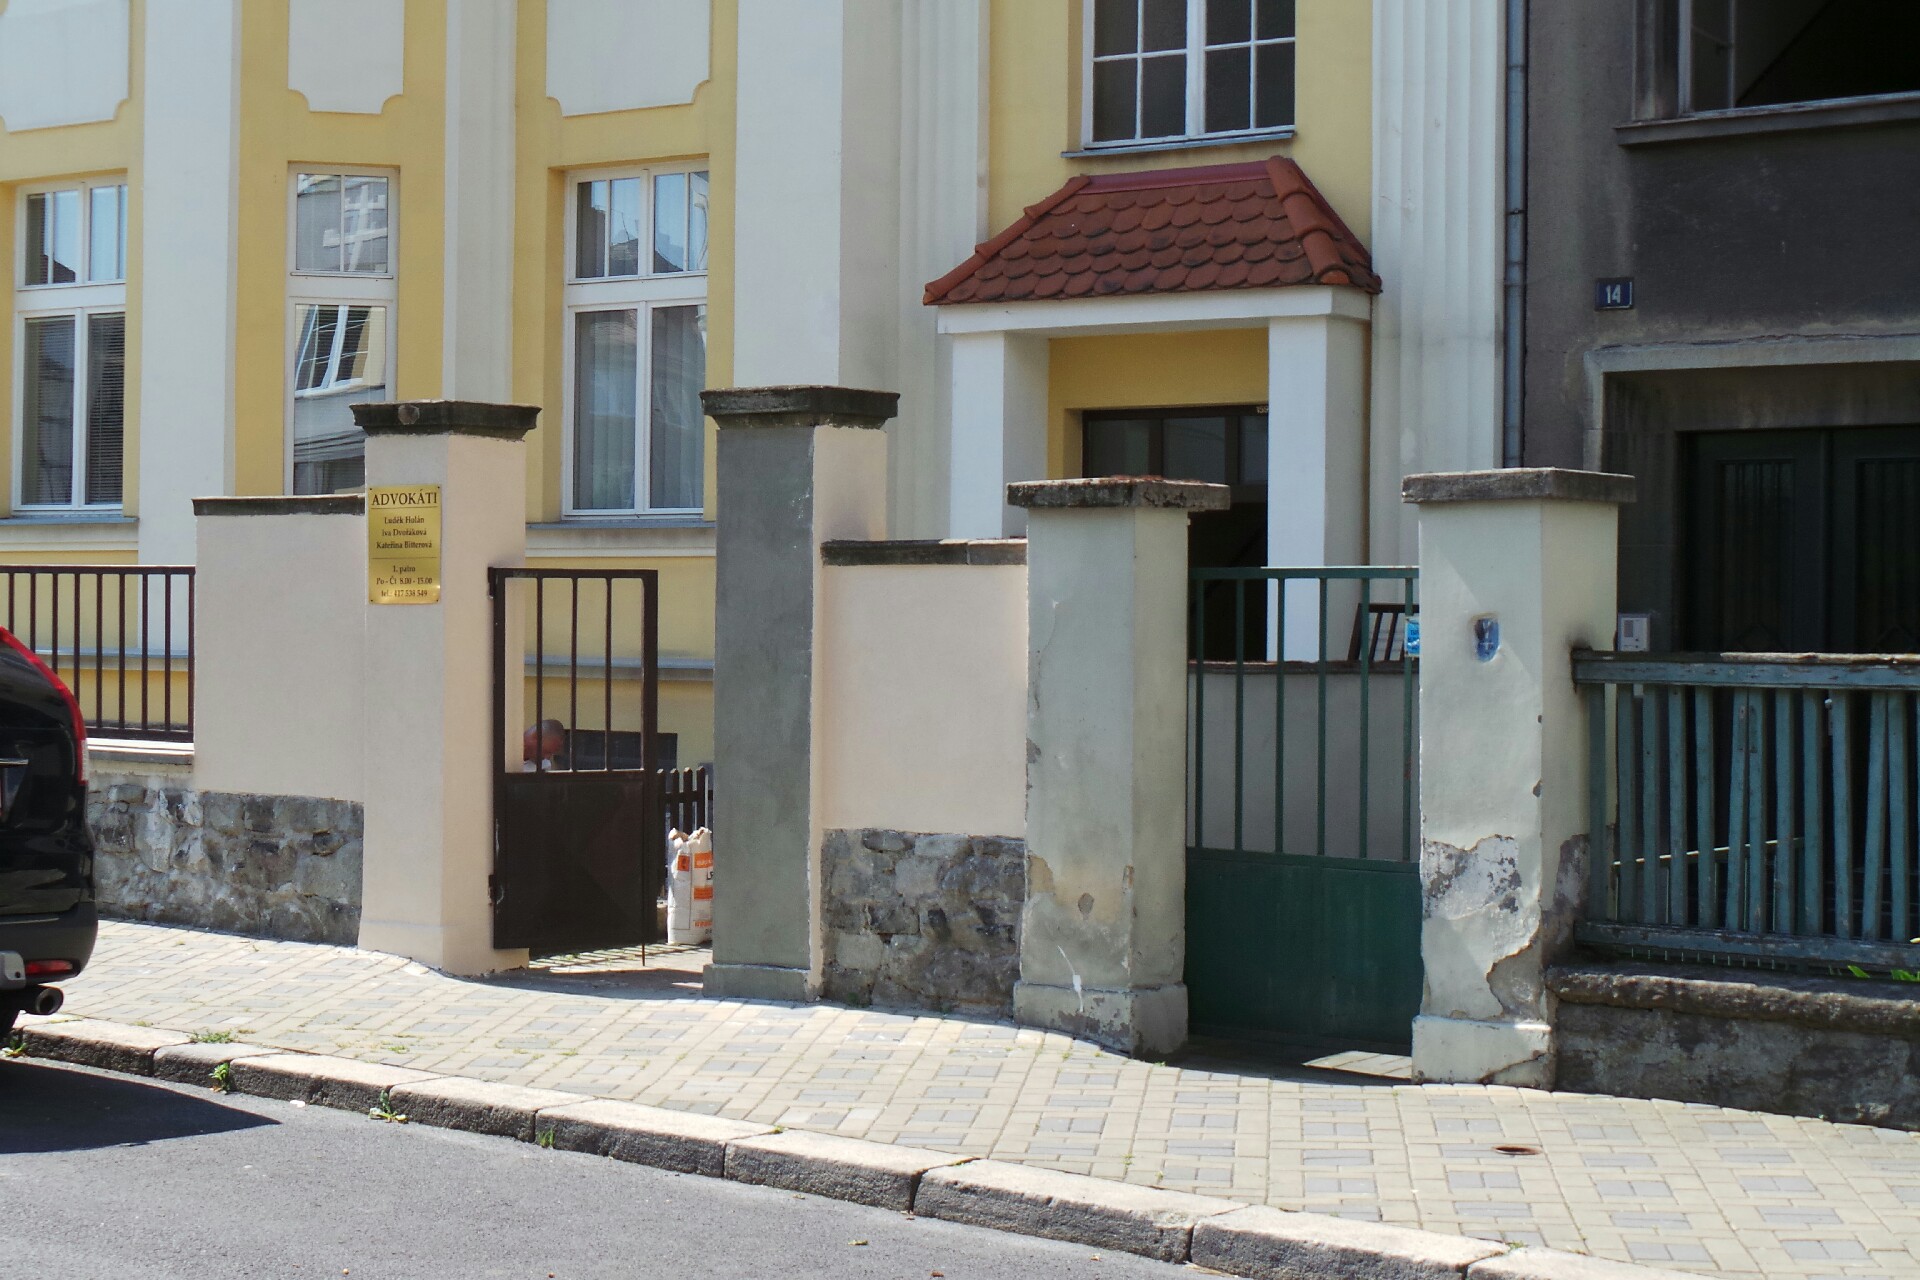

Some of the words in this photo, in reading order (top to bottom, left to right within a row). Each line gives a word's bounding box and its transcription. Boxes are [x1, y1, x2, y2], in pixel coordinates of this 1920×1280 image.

[1605, 284, 1621, 304] 14
[372, 489, 437, 506] ADVOKÁTI
[384, 516, 404, 524] Luděk
[405, 515, 425, 524] Holán
[392, 528, 427, 536] Dvořáková
[376, 541, 403, 549] Kateřina
[404, 540, 432, 549] Bitterová
[393, 565, 398, 573] 1.
[399, 565, 416, 575] patro
[376, 577, 385, 585] Po
